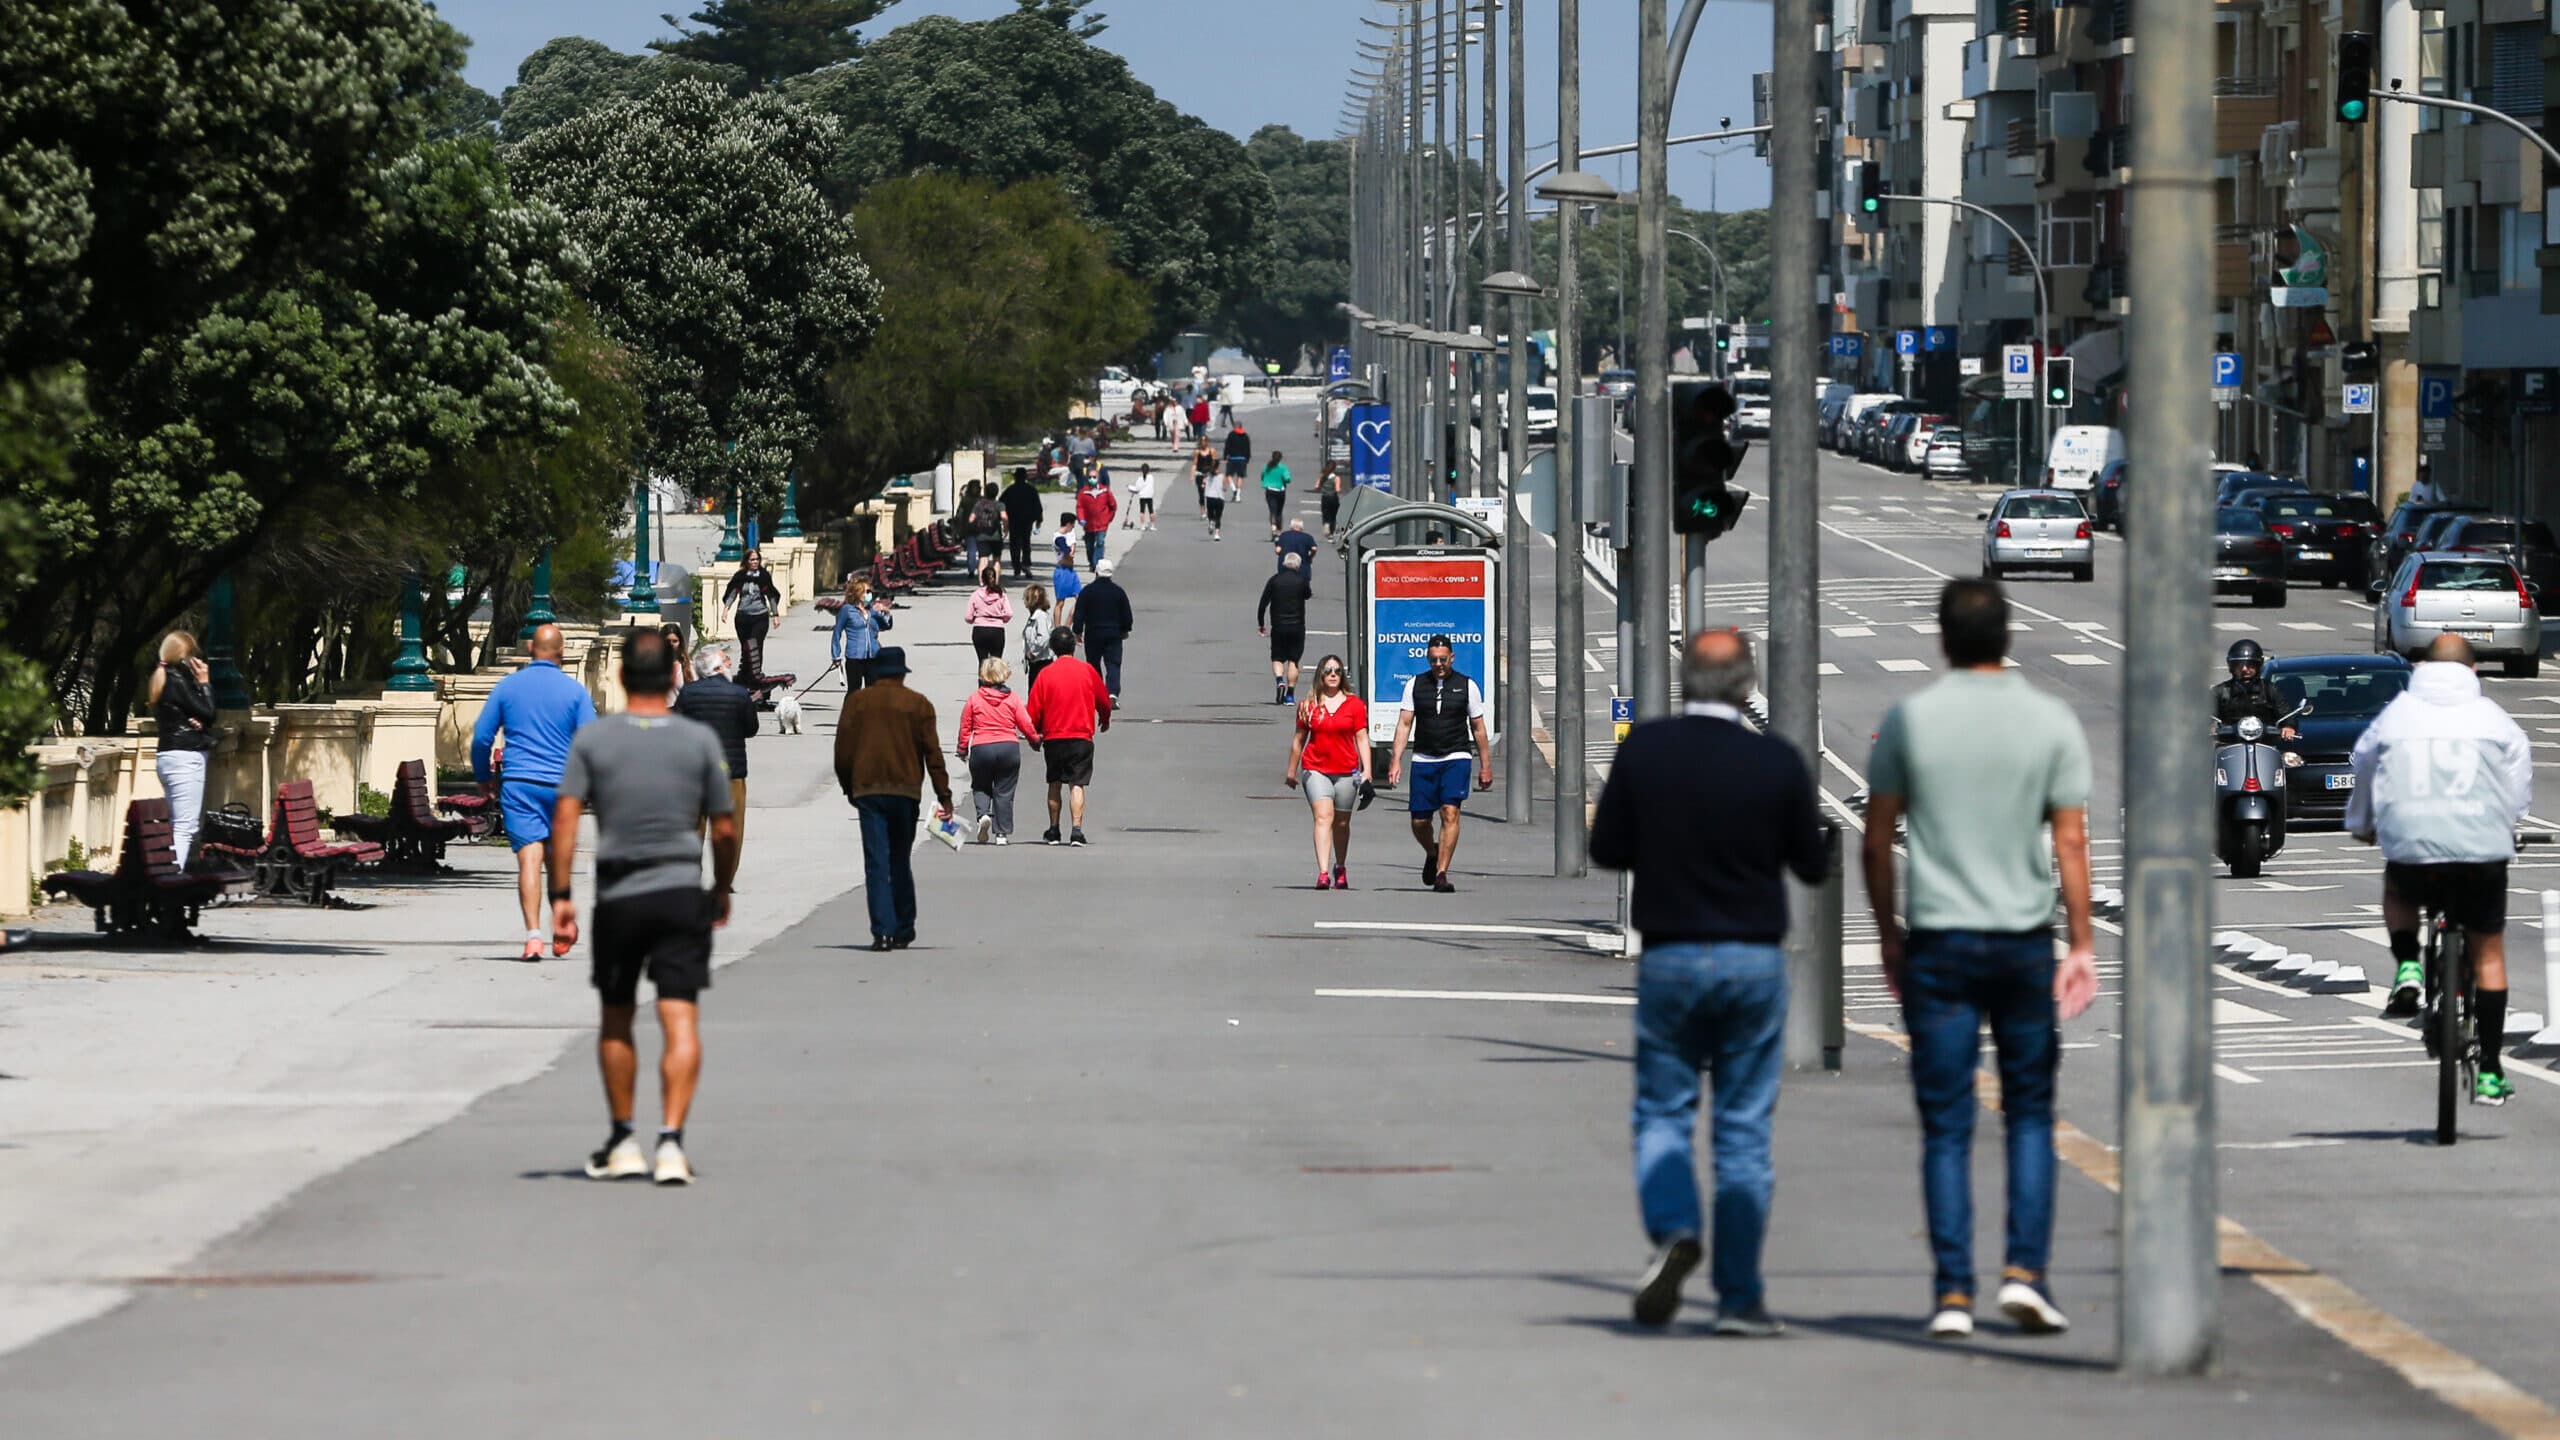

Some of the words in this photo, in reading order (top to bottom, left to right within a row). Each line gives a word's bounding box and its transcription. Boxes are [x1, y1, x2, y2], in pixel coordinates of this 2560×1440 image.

[1832, 337, 1844, 353] P
[1846, 338, 1858, 354] P
[1900, 334, 1914, 351] P
[2013, 356, 2025, 373] P
[2216, 356, 2236, 384] P
[2348, 385, 2362, 404] P
[2427, 381, 2446, 413] P
[1377, 633, 1482, 644] DISTANCIENTO
[2399, 738, 2481, 798] 19
